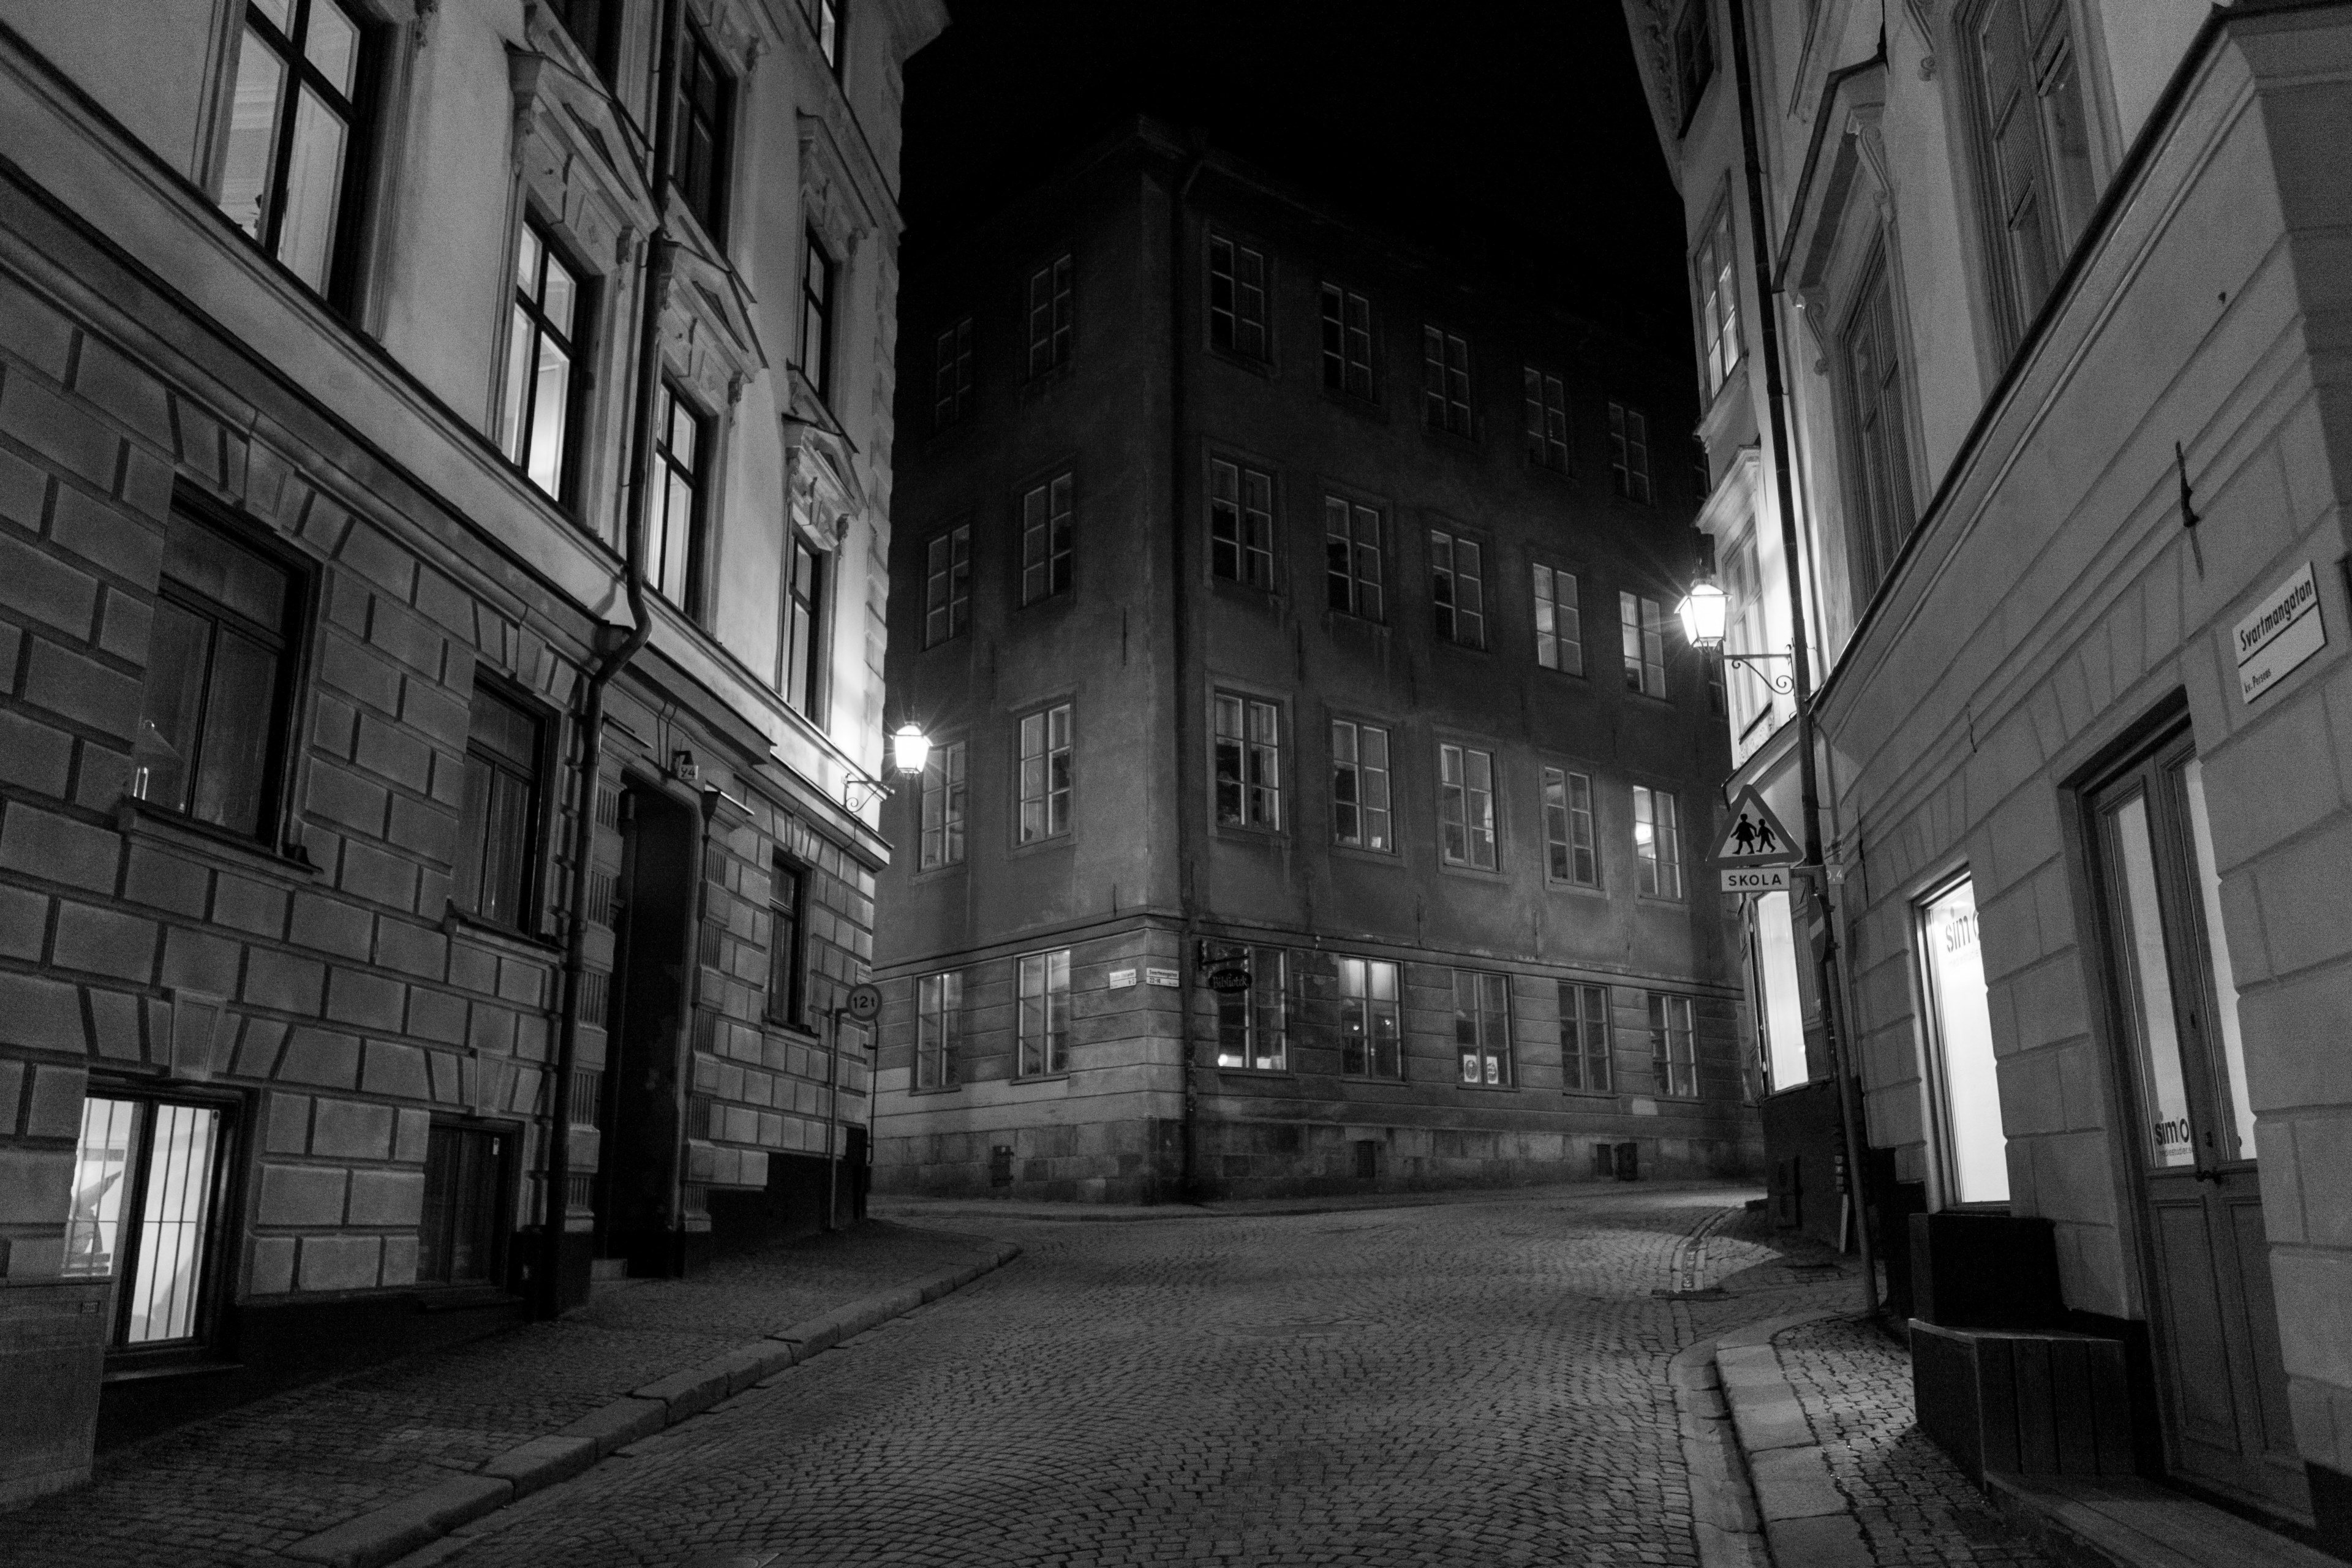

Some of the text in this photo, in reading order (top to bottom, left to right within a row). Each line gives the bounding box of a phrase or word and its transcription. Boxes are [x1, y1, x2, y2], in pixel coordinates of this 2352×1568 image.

[2239, 579, 2312, 652] Svartmangatan
[2252, 668, 2271, 688] Perseus
[1728, 873, 1782, 886] SKOLA
[853, 996, 868, 1008] 12
